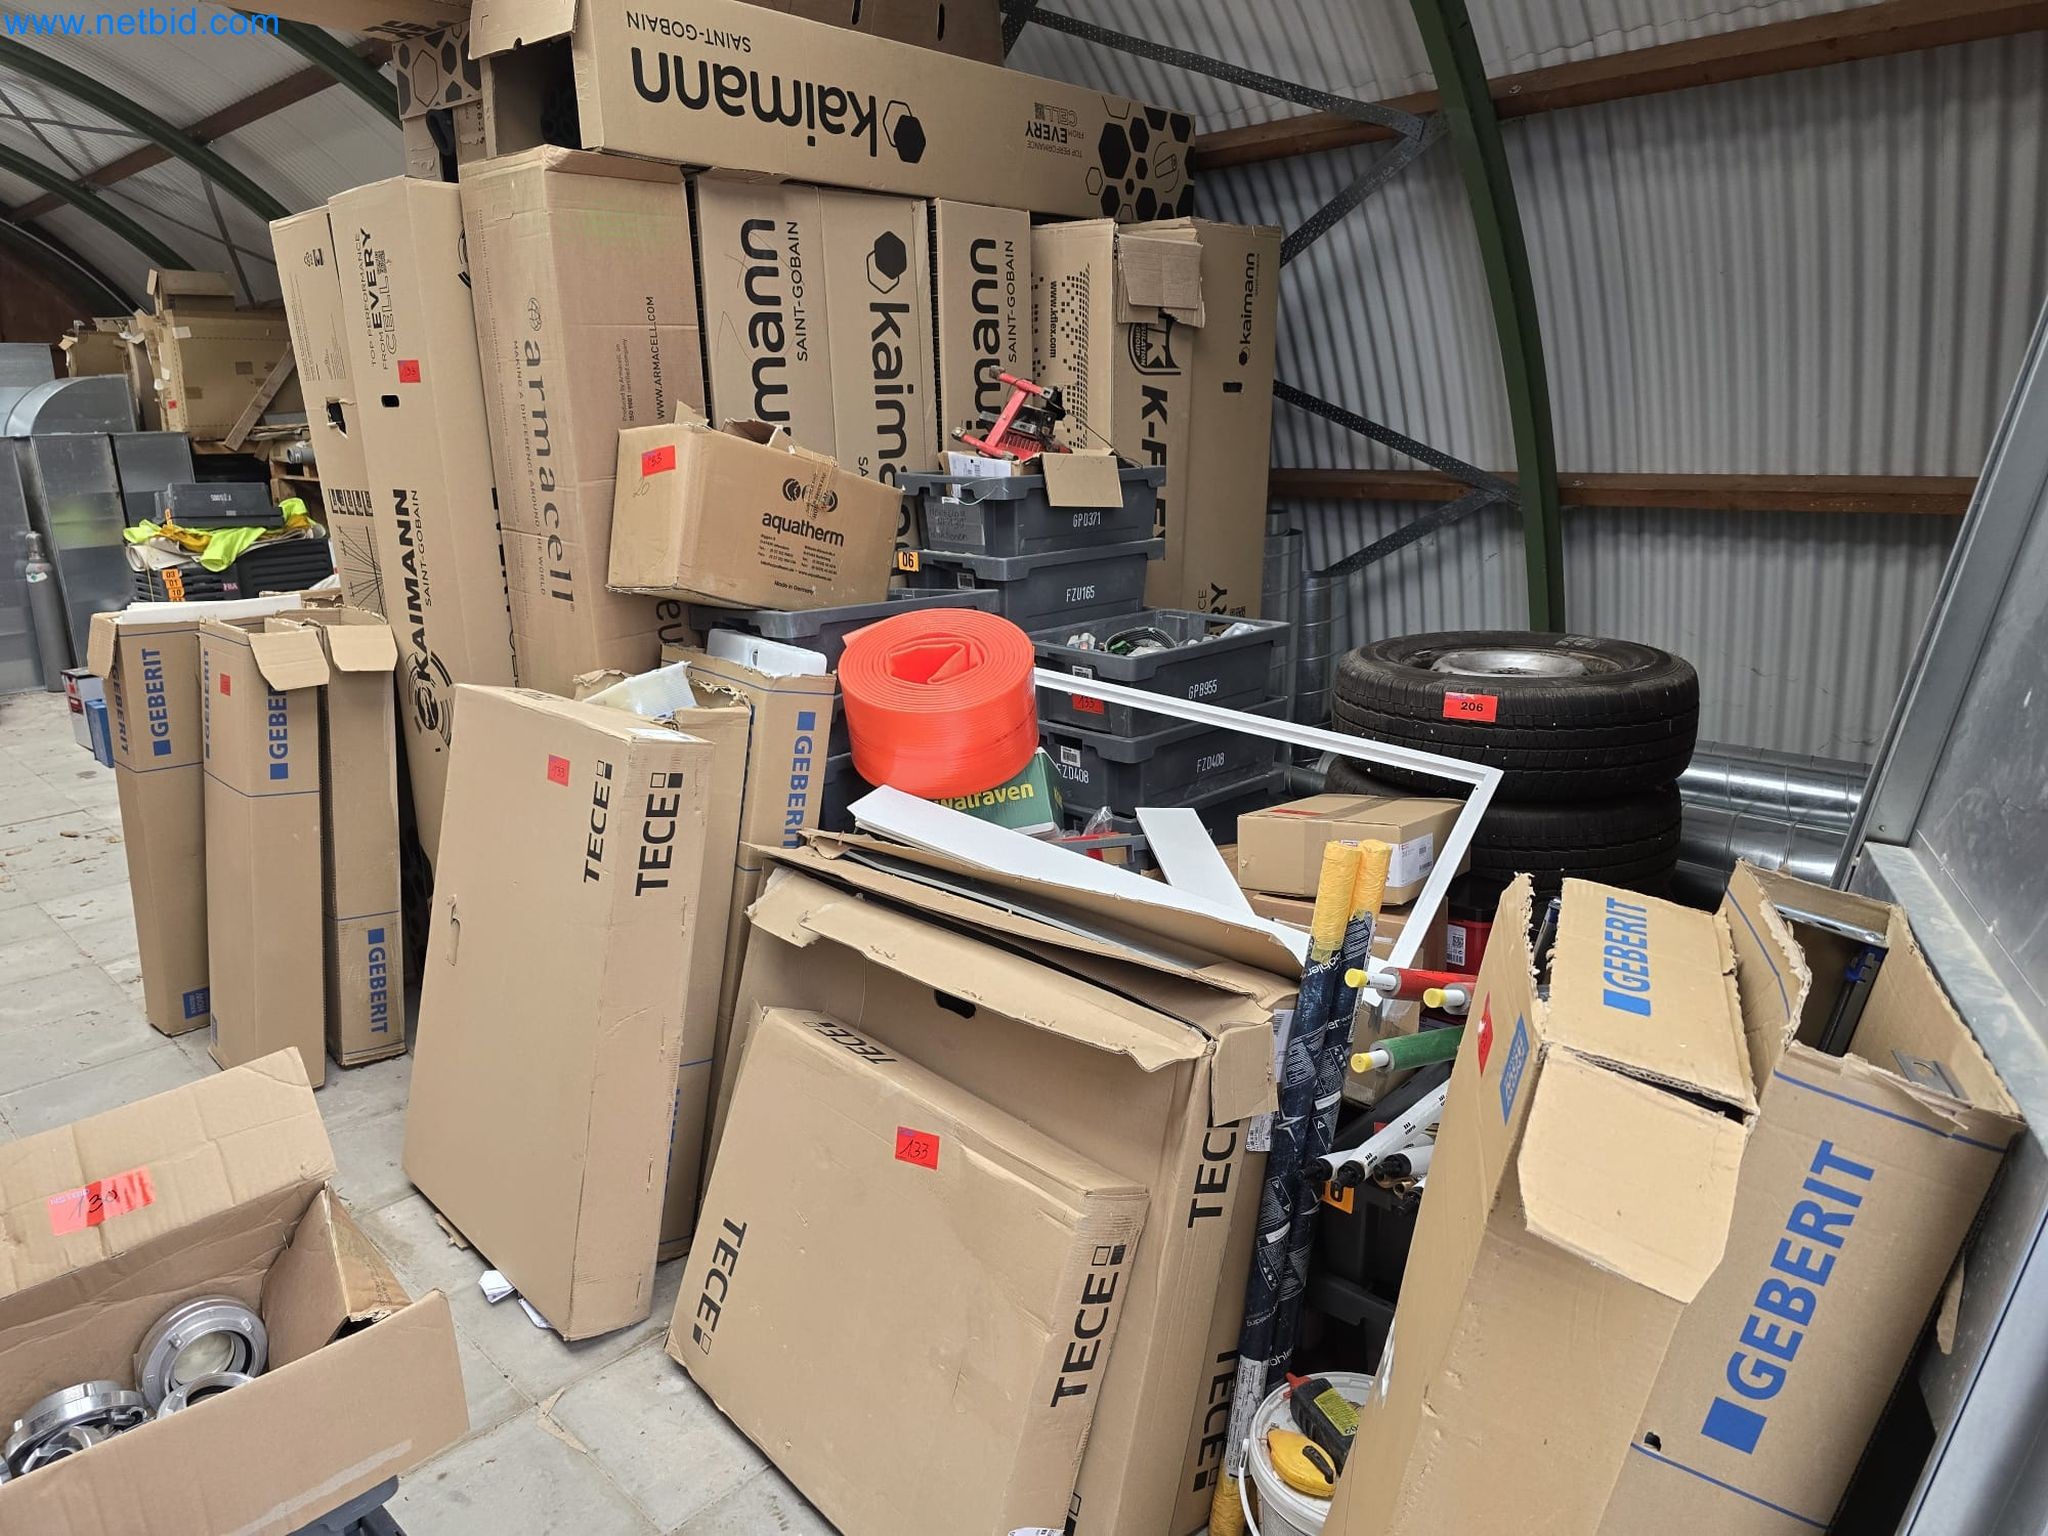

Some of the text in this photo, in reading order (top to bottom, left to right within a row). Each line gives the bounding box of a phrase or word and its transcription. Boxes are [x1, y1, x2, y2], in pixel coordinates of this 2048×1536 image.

[626, 10, 751, 53] SAINT-GOBAIN
[631, 47, 877, 157] kaimann
[1025, 120, 1067, 144] EVERY
[355, 234, 374, 337] PERFORMANCE
[360, 228, 389, 370] FROM EVERY
[740, 218, 791, 436] mann
[786, 221, 808, 362] SAINT-GOBAIN
[1004, 241, 1017, 363] SAINT-GOBAIN
[1050, 280, 1058, 358] www.kflex.com
[1239, 253, 1255, 345] kaimann
[645, 296, 665, 420] WWW.ARMACELL.COM
[514, 340, 523, 386] MAKING
[520, 403, 534, 474] DIFFERENCE
[529, 480, 540, 528] AROUND
[538, 556, 547, 596] WORLD
[524, 339, 575, 608] armacell
[166, 571, 176, 579] 03
[410, 489, 432, 607] SAINT-GOBAIN
[761, 512, 845, 548] aquatherm
[902, 553, 914, 569] 06
[392, 488, 431, 682] KAIMANN
[1066, 585, 1095, 603] FZU165
[142, 648, 171, 737] GEBERIT
[1461, 702, 1484, 712] 206
[583, 781, 611, 883] TECE
[635, 793, 680, 897] TECE
[368, 947, 388, 1033] GEBERIT
[1603, 897, 1652, 993] GEBERIT
[815, 1028, 898, 1065] TECE
[898, 1139, 929, 1159] 133
[696, 1218, 747, 1333] TECE
[1726, 1140, 1875, 1401] GEBERIT
[1050, 1271, 1119, 1408] TECE
